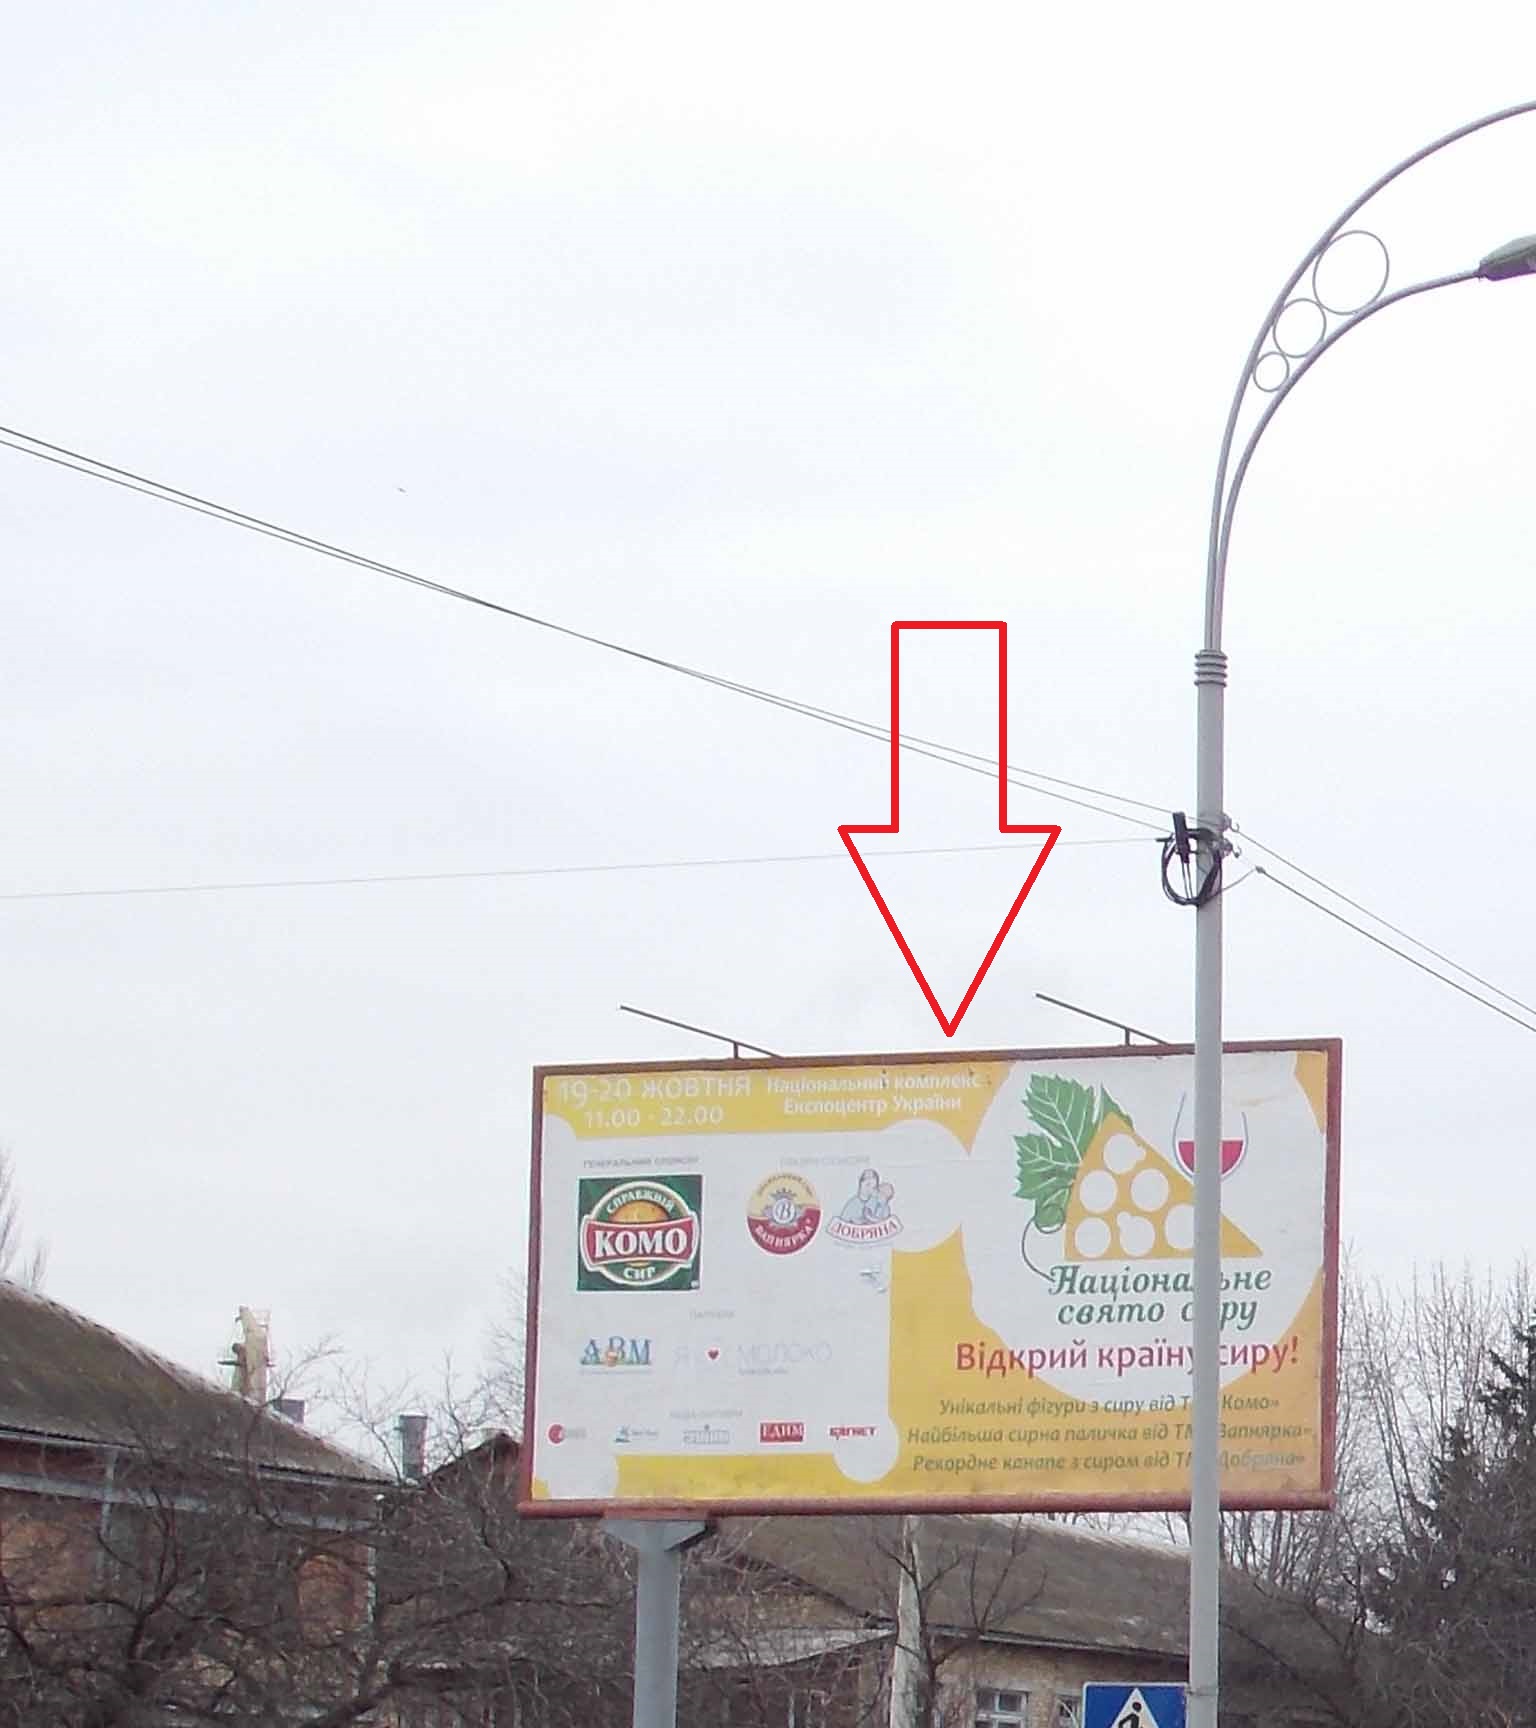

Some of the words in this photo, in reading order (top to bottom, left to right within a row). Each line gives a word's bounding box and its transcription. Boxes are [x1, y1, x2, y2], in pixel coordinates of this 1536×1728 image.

[558, 1077, 632, 1109] 19-20
[641, 1075, 750, 1099] ЖОВТНЯ
[894, 1073, 981, 1091] комплекс
[585, 1107, 641, 1129] 11.00
[659, 1105, 724, 1127] 22.00
[783, 1098, 887, 1117] Експоцентр
[893, 1094, 962, 1116] України
[593, 1226, 688, 1259] КОМО
[1049, 1264, 1272, 1301] Націонаьне
[1057, 1300, 1166, 1326] свято
[1180, 1298, 1258, 1331] сру
[956, 1337, 1088, 1379] Відкрий
[939, 1396, 1024, 1416] Унікальні
[1026, 1396, 1086, 1419] фігури
[1091, 1401, 1099, 1412] з
[1103, 1399, 1145, 1417] сиру
[1149, 1394, 1175, 1412] від
[907, 1427, 1004, 1445] Найбільша
[1007, 1428, 1061, 1447] сирна
[1063, 1426, 1138, 1443] паличка
[1142, 1422, 1169, 1441] від
[912, 1454, 999, 1475] Рекордне
[1083, 1454, 1139, 1474] сиром
[1142, 1451, 1170, 1468] від
